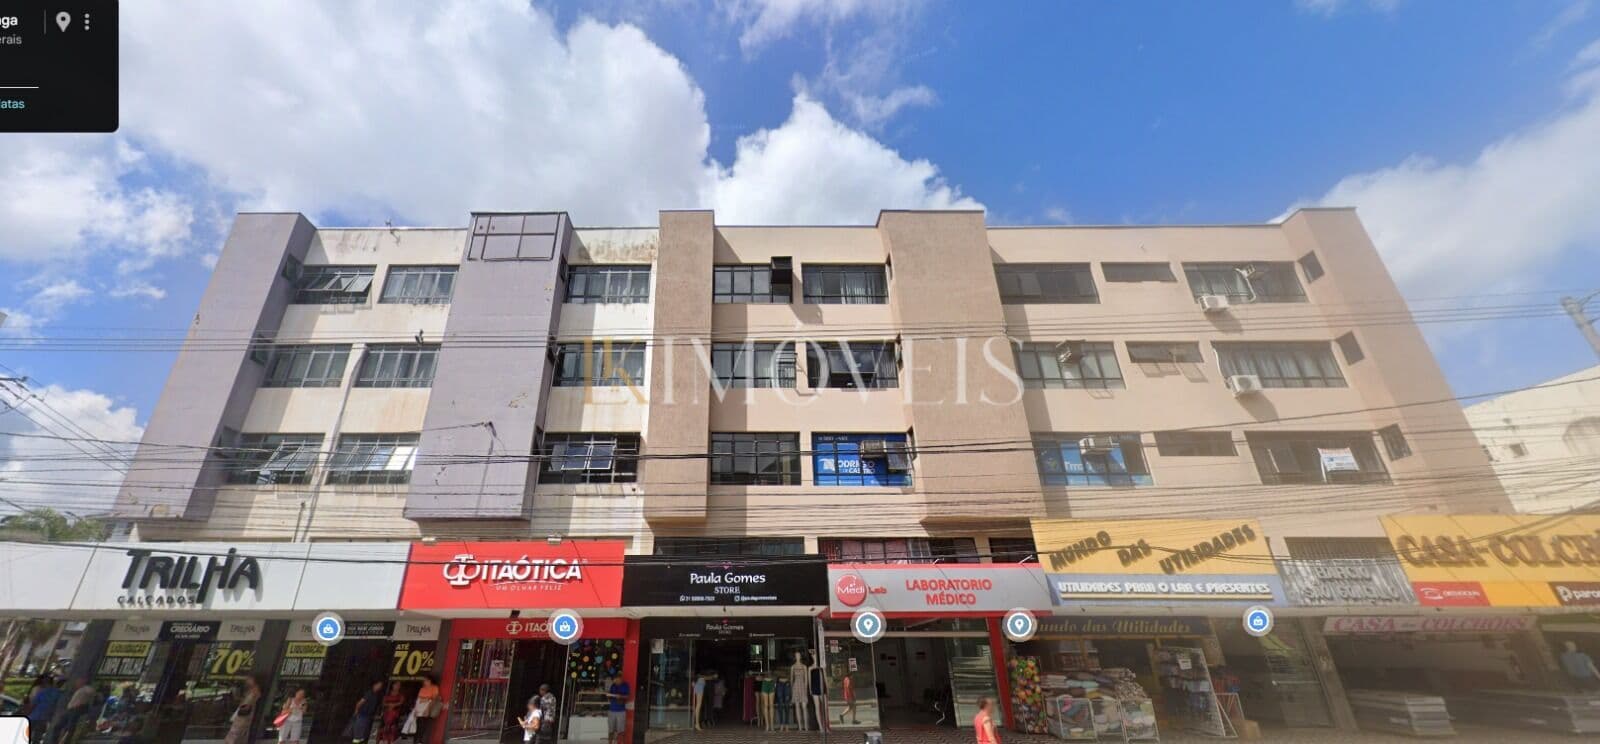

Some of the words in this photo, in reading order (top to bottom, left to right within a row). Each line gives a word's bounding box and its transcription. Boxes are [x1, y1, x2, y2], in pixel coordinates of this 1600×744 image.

[1049, 530, 1112, 572] MUNDO
[1117, 538, 1153, 567] DAS
[1159, 524, 1257, 575] UTILIDADES
[1397, 534, 1488, 567] CASA
[480, 554, 583, 581] ITAÓTICA
[121, 547, 260, 604] TRILHA
[690, 572, 721, 584] Paula
[724, 572, 766, 584] Gomes
[714, 586, 740, 594] STORE
[837, 584, 865, 595] Medi
[905, 579, 993, 592] LABORATORIO
[1057, 581, 1122, 594] UTILIDADES
[926, 591, 977, 606] MÉDICO
[1039, 619, 1076, 632] undo
[393, 650, 434, 675] 70%
